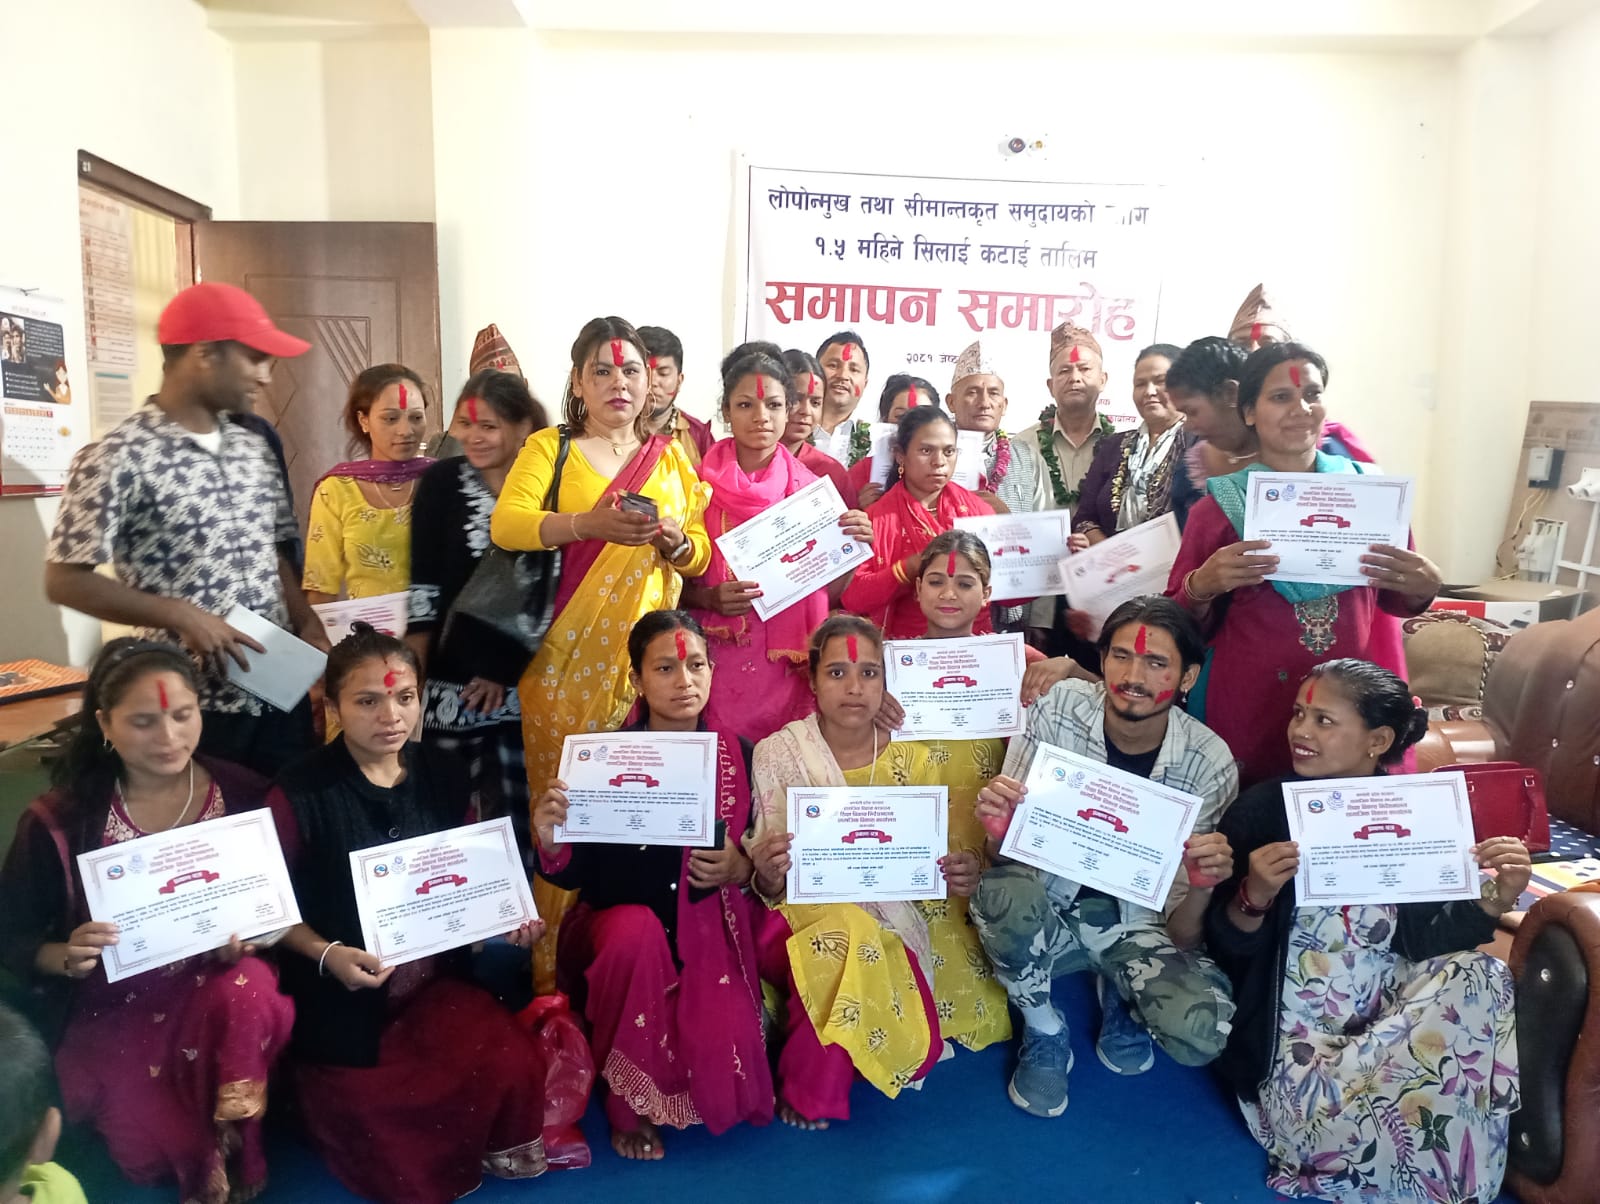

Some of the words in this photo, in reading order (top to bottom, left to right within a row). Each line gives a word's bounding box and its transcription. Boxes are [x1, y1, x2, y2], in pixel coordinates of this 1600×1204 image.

[768, 185, 851, 219] लोपोन्मुख
[860, 196, 895, 215] तथा
[904, 193, 999, 226] सीमान्तकृत
[1008, 200, 1096, 228] समुदायको
[815, 236, 845, 261] १.५
[857, 232, 904, 263] महिने
[913, 234, 971, 265] सिलाई
[980, 240, 1031, 268] कटाई
[1041, 241, 1098, 268] तालिम
[765, 281, 942, 327] समापन
[958, 281, 1135, 341] समारोह
[906, 353, 933, 364] २०८१
